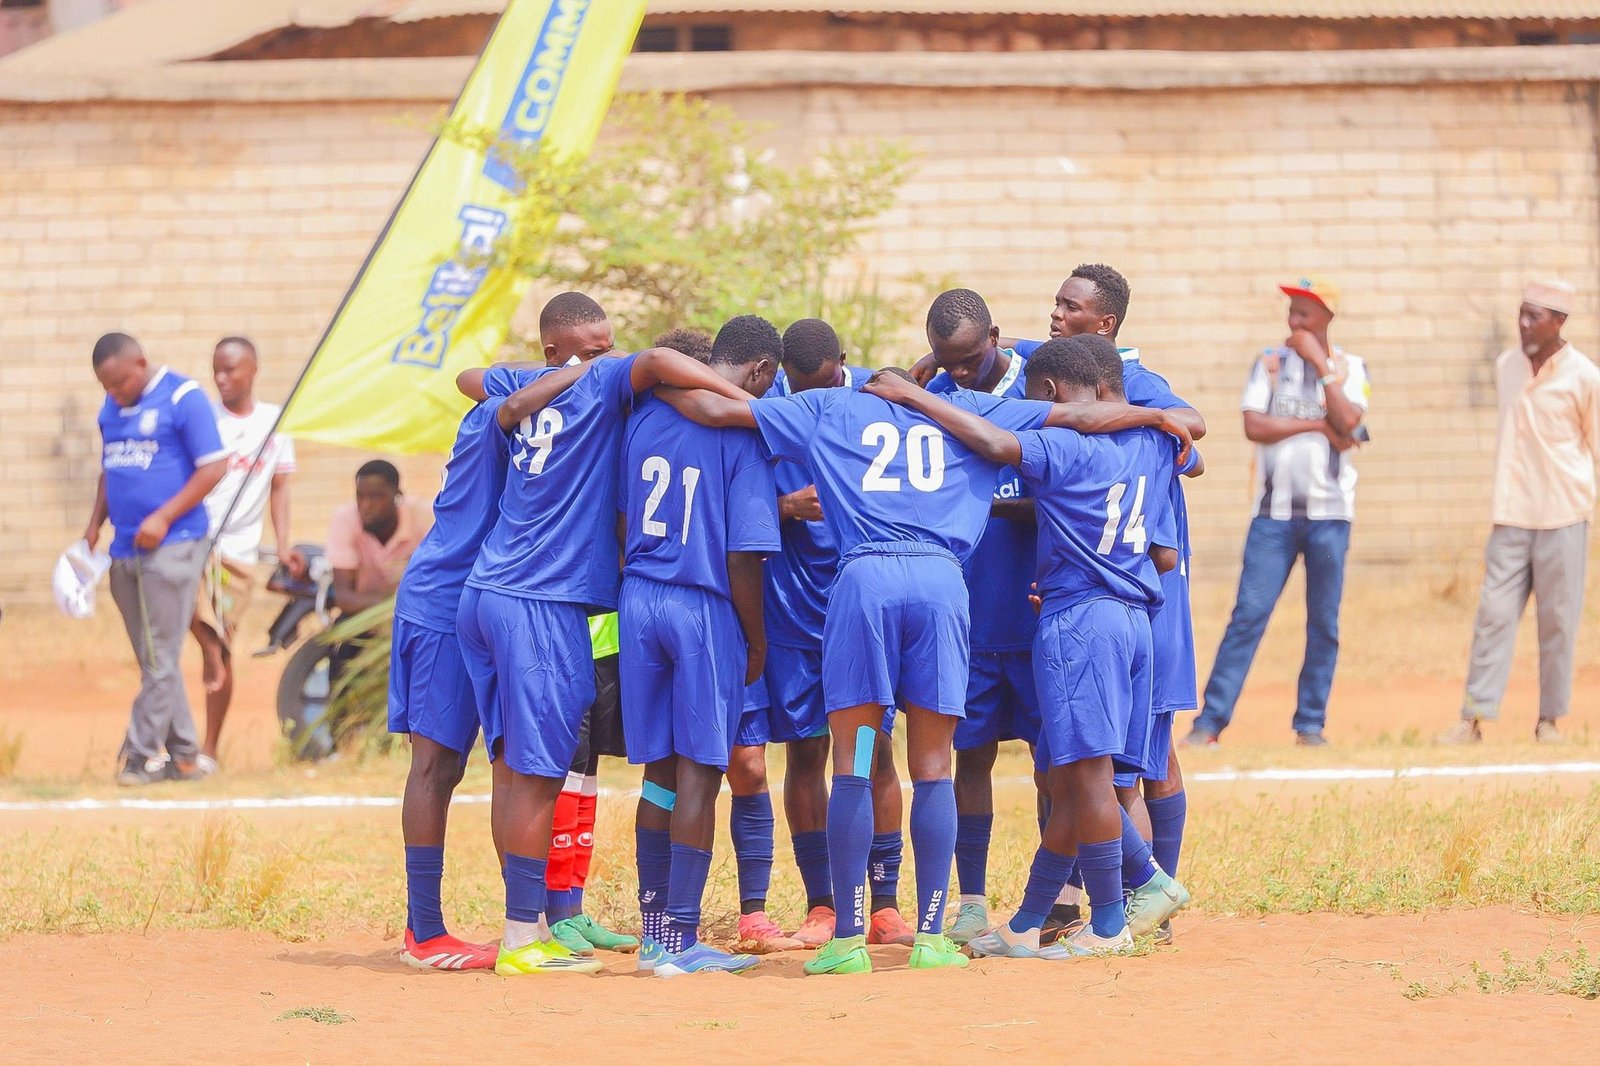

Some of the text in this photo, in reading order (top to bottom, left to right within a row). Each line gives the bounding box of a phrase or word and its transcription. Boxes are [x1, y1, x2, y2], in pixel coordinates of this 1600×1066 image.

[861, 422, 945, 492] 20
[642, 456, 700, 545] 21
[1097, 475, 1147, 555] 14
[854, 885, 864, 927] PARIS
[921, 890, 942, 931] PARIS
